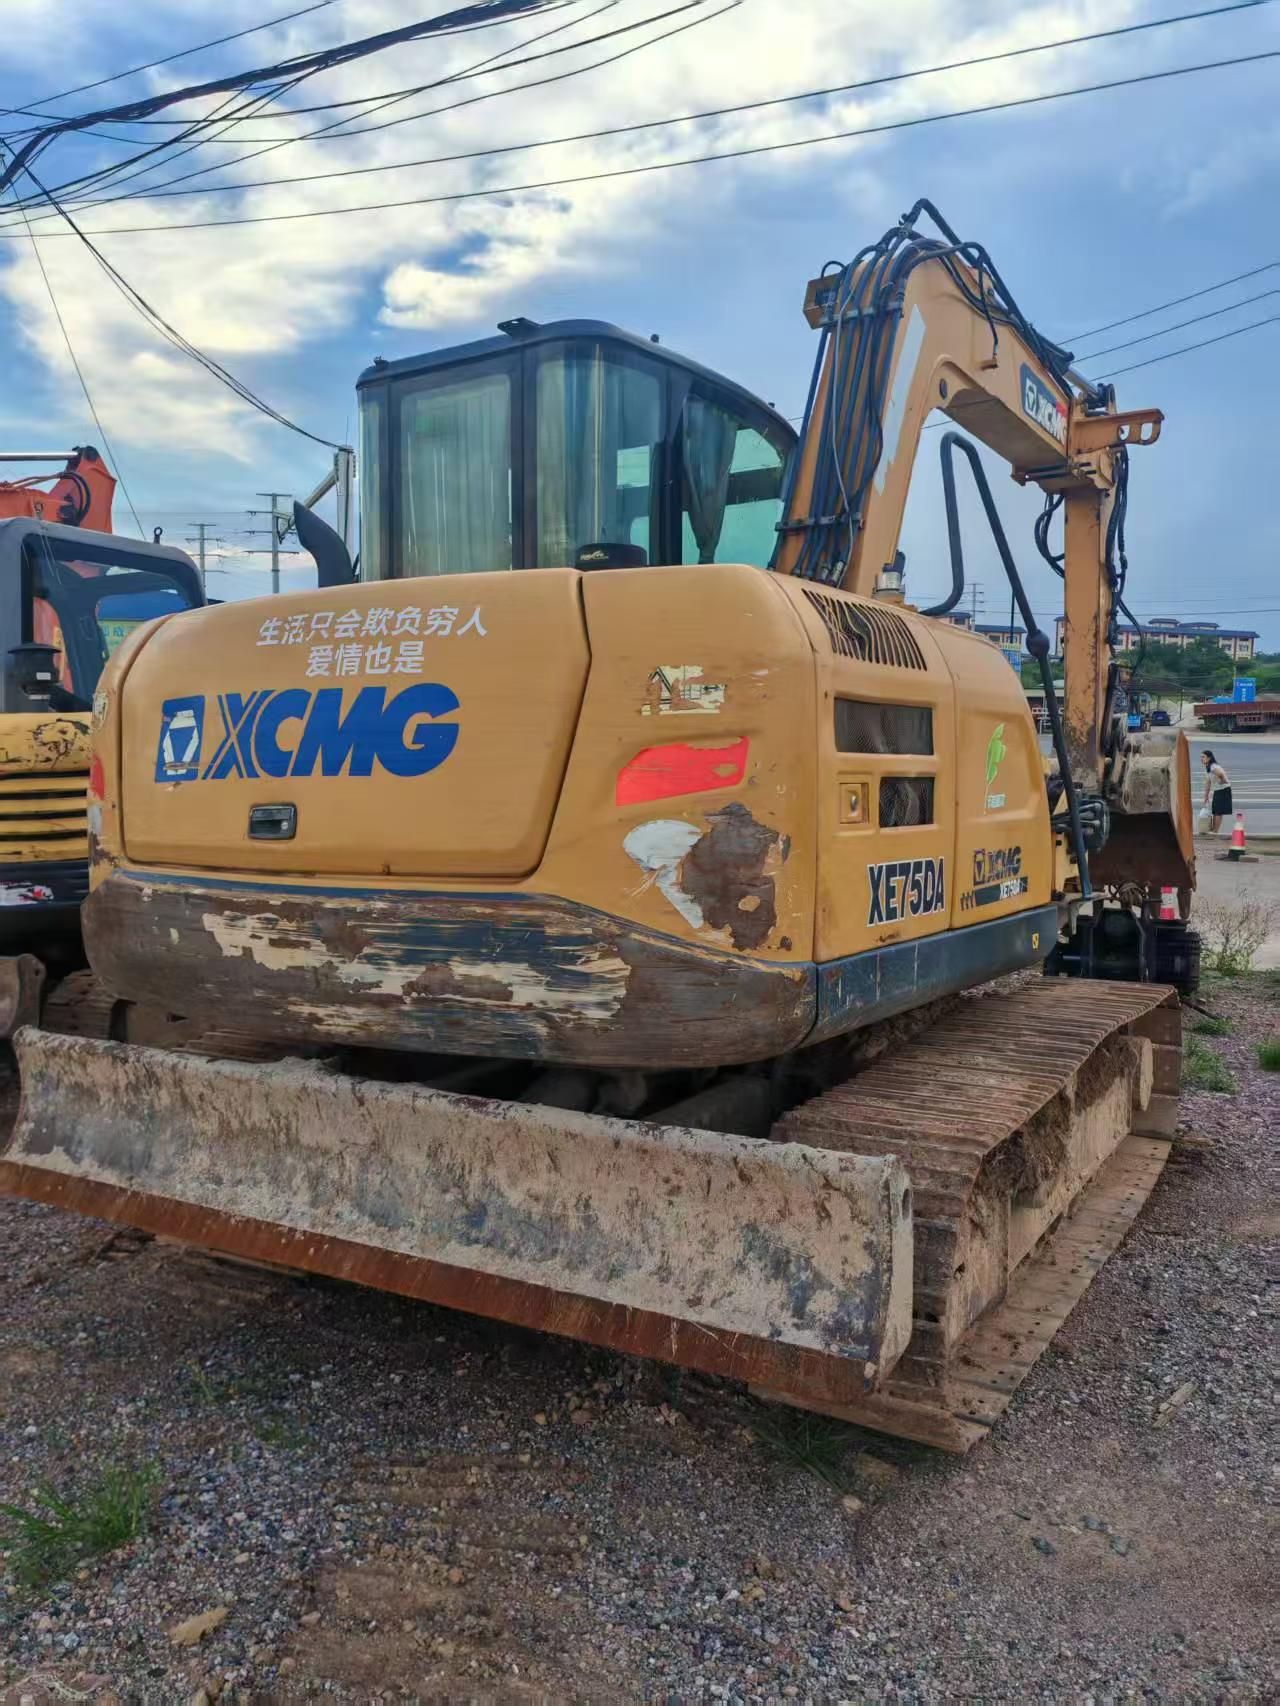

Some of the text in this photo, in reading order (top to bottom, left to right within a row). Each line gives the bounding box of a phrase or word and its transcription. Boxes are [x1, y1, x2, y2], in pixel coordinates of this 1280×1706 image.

[256, 605, 488, 646] 生活只会欺负穷人
[305, 640, 425, 677] 爱情也是
[201, 682, 461, 780] XCMG
[866, 856, 945, 927] XE75DA
